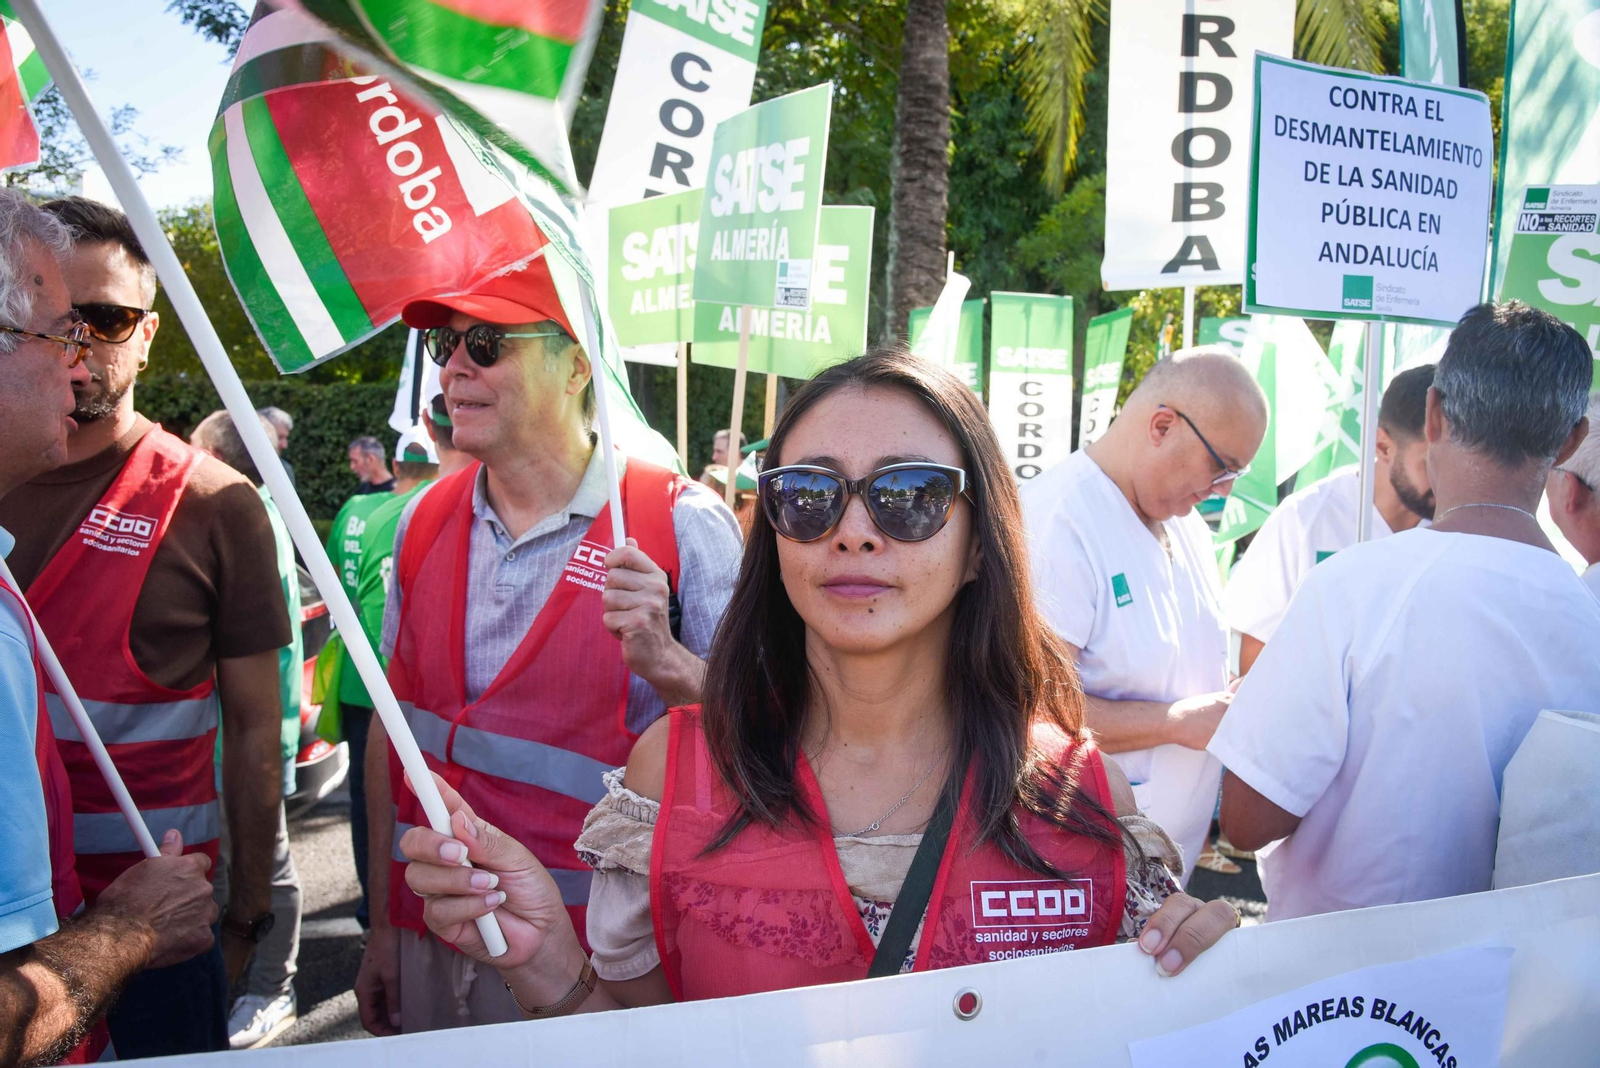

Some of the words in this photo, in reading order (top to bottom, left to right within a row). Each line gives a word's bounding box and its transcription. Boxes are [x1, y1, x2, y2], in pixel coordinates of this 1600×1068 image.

[1329, 85, 1418, 118] CONTRA
[1424, 99, 1444, 122] EL
[1160, 14, 1238, 274] RDOBA
[1274, 114, 1483, 169] DESMANTELAMIENTO
[350, 75, 452, 244] rdoba
[710, 136, 811, 218] SATSE
[1304, 160, 1330, 184] DE
[1338, 165, 1364, 188] LA
[1371, 168, 1458, 200] SANIDAD
[1321, 198, 1412, 231] PÚBLICA
[1418, 212, 1441, 235] EN
[1520, 214, 1540, 231] NO
[1547, 222, 1594, 232] SANIDAD
[1554, 214, 1596, 223] RECORTES
[710, 219, 790, 262] ALMERÍA
[1318, 241, 1439, 273] ANDALUCÍA
[630, 283, 696, 315] ALME
[1343, 297, 1372, 307] SATSE
[1376, 283, 1406, 294] Sindicato
[1376, 295, 1385, 303] de
[996, 346, 1069, 370] SATSE
[1015, 381, 1044, 481] CORDO
[88, 508, 152, 537] CCOO
[79, 527, 109, 541] sanidad
[110, 536, 117, 544] y
[116, 536, 149, 548] sectores
[82, 538, 140, 556] sociosanitarios
[573, 545, 606, 568] CC
[566, 574, 605, 592] sociosanit
[594, 574, 601, 582] y
[981, 889, 1086, 917] CCOO
[975, 929, 1027, 943] sanidad
[1031, 931, 1038, 943] y
[1042, 927, 1088, 941] sectores
[1272, 995, 1364, 1046] MAREAS
[1370, 998, 1457, 1068] BLANCAS
